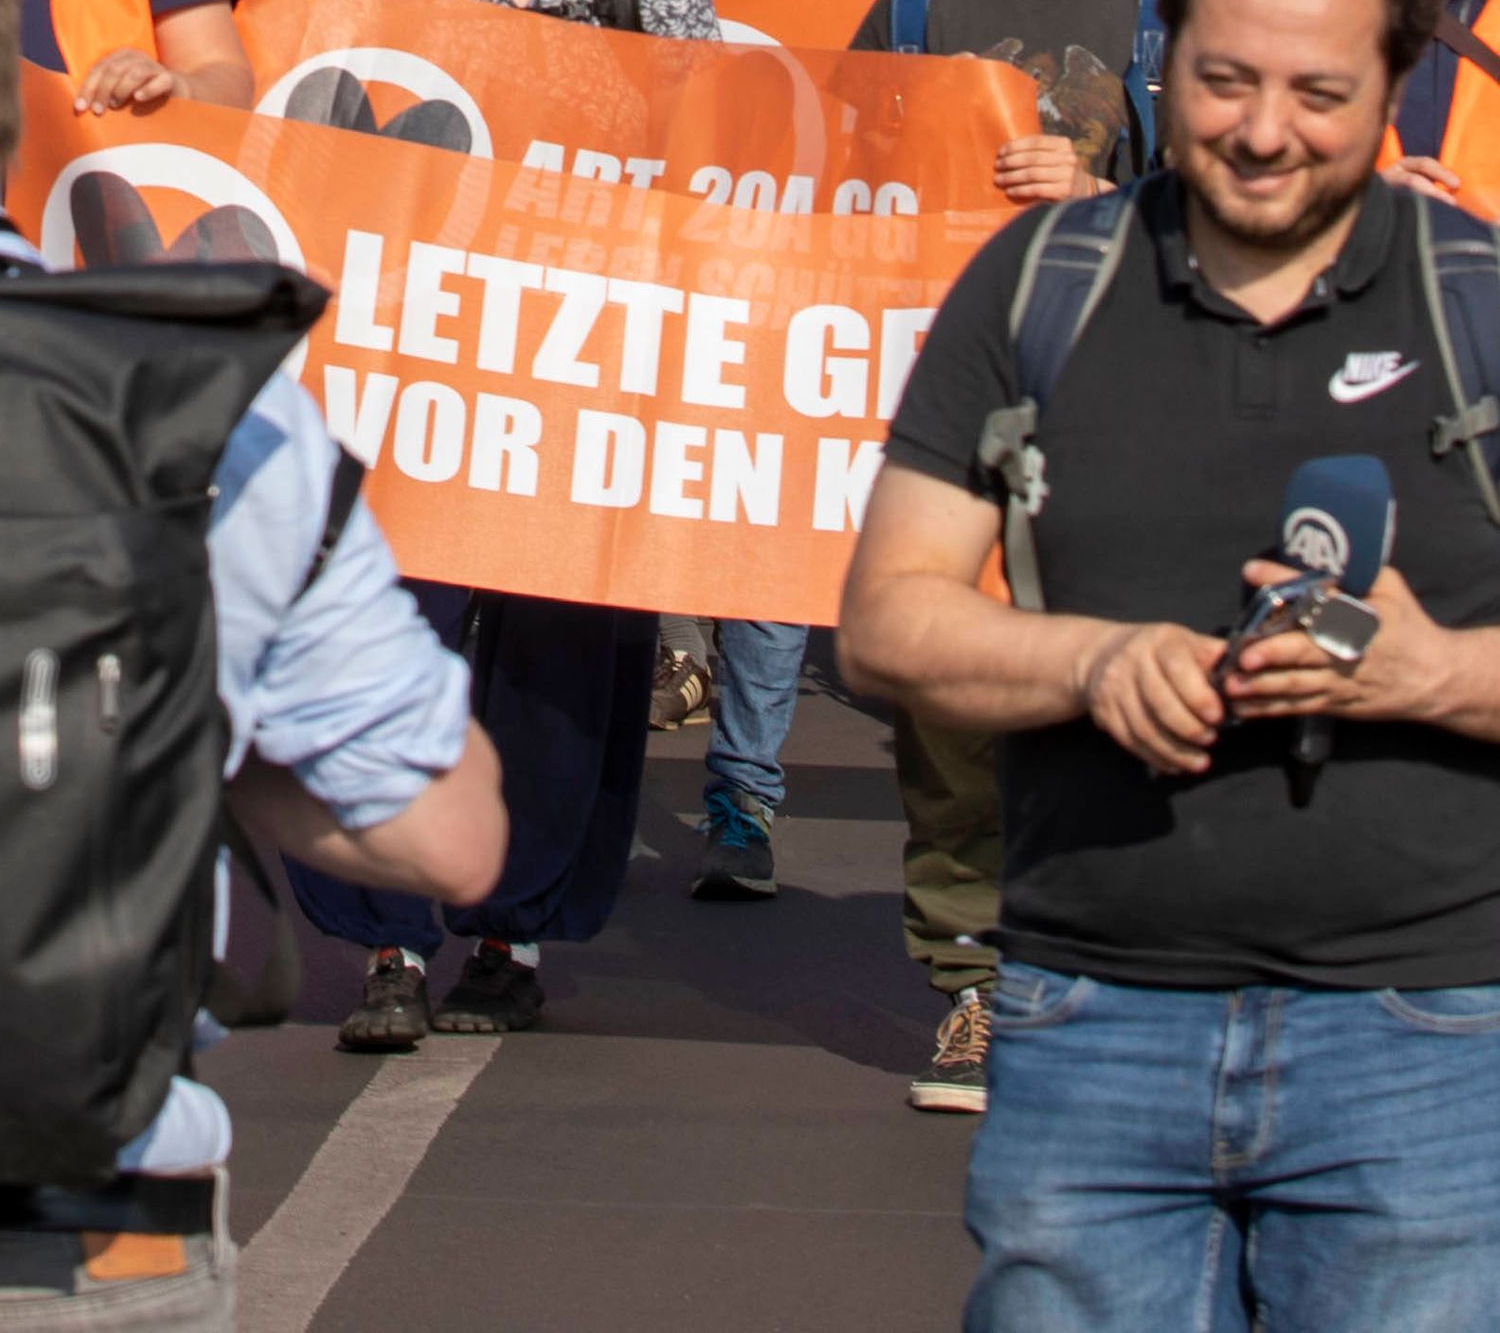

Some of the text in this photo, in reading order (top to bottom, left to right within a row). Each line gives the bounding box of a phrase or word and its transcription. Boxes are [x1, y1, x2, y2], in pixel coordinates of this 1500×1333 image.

[334, 229, 750, 410] LETZTE
[1344, 351, 1402, 382] NIKE
[323, 364, 543, 498] VOR
[570, 408, 784, 527] DEN
